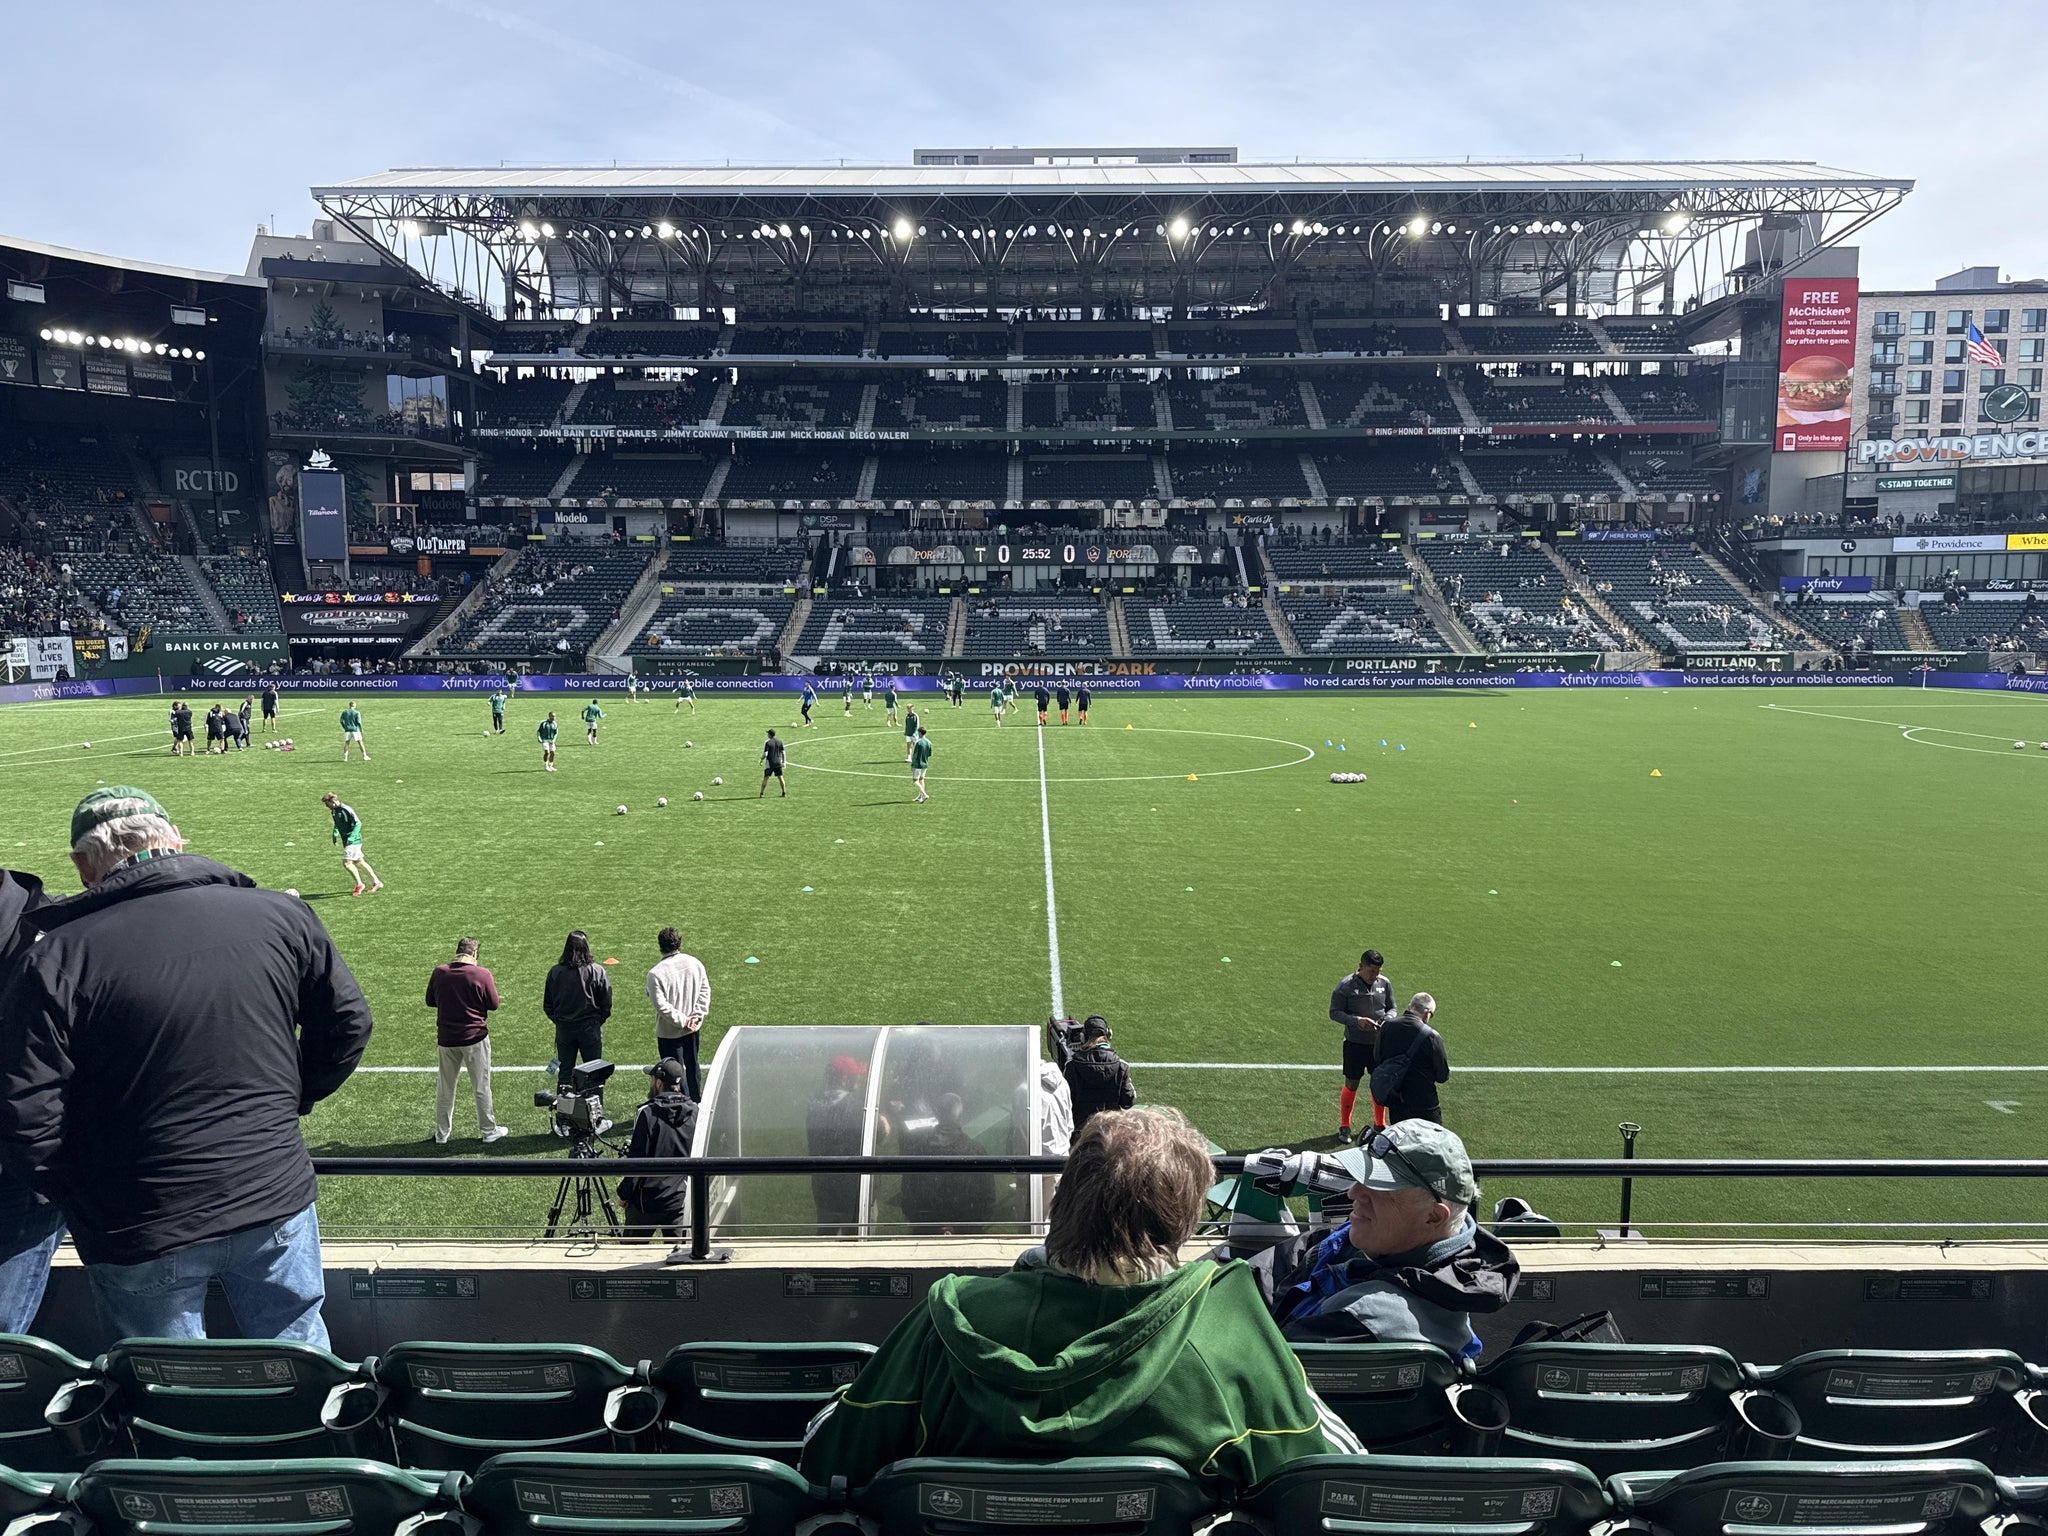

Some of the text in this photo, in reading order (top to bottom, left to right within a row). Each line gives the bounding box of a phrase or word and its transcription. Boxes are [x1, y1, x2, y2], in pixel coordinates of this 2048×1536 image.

[1802, 291, 1839, 304] FREE
[1788, 307, 1850, 316] McChicken®
[1788, 318, 1850, 326] when Timbers win
[1790, 328, 1848, 336] with $2 purchase
[1786, 338, 1850, 346] day after the game.
[86, 365, 126, 376] CHAMPIONS
[134, 371, 172, 382] CHAMPIONS
[88, 383, 128, 393] CHAMPIONS
[480, 429, 498, 437] RING
[505, 429, 532, 437] HONOR
[538, 429, 562, 437] JOHN
[564, 429, 584, 437] BAIN
[663, 430, 690, 438] JIMMY
[692, 430, 728, 438] CONWAY
[735, 430, 768, 438] TIMBER
[770, 430, 786, 438] JIM
[790, 430, 813, 439] MICK
[814, 431, 844, 439] HOBAN
[850, 431, 876, 439] DIEGO
[878, 431, 909, 439] VALERI
[1428, 427, 1462, 435] CHRISTINE
[1857, 430, 2048, 464] PROVIDENCE
[1887, 479, 1953, 488] STAND TOGETHER
[422, 496, 462, 510] Modelo
[308, 508, 338, 516] Tillamook
[555, 511, 588, 523] Modelo
[820, 515, 838, 523] DSP
[1842, 542, 1855, 550] TL
[1931, 539, 1982, 549] Providence
[998, 545, 1010, 563] 0
[1022, 548, 1051, 559] 25:52
[1064, 545, 1075, 563] 0
[1807, 579, 1843, 592] xfinity
[1986, 580, 2015, 590] Ford
[302, 610, 406, 620] OLD TRAPPER
[38, 642, 62, 650] BLACK
[165, 641, 279, 651] BANK OF AMERICA
[1346, 660, 1416, 670] PORTLAND
[1686, 656, 1756, 668] PORTLAND
[1107, 662, 1156, 675] PARK
[191, 678, 206, 688] No
[208, 678, 226, 688] red
[228, 678, 256, 688] cards
[275, 680, 300, 690] your
[302, 678, 337, 688] mobile
[340, 678, 398, 688] connection
[442, 678, 523, 690] xfinity mobe
[565, 678, 774, 690] No red your connection
[1183, 677, 1263, 689] xfinity mobile
[1304, 677, 1515, 689] No red cards for your mobile connection
[1560, 675, 1640, 687] xfinity mobile
[1683, 674, 1894, 686] No red cards for your mobile connection
[2006, 675, 2034, 689] xfinity
[32, 684, 92, 698] xfinity mobile
[524, 1491, 546, 1500] PARK
[1331, 1492, 1354, 1502] PARK
